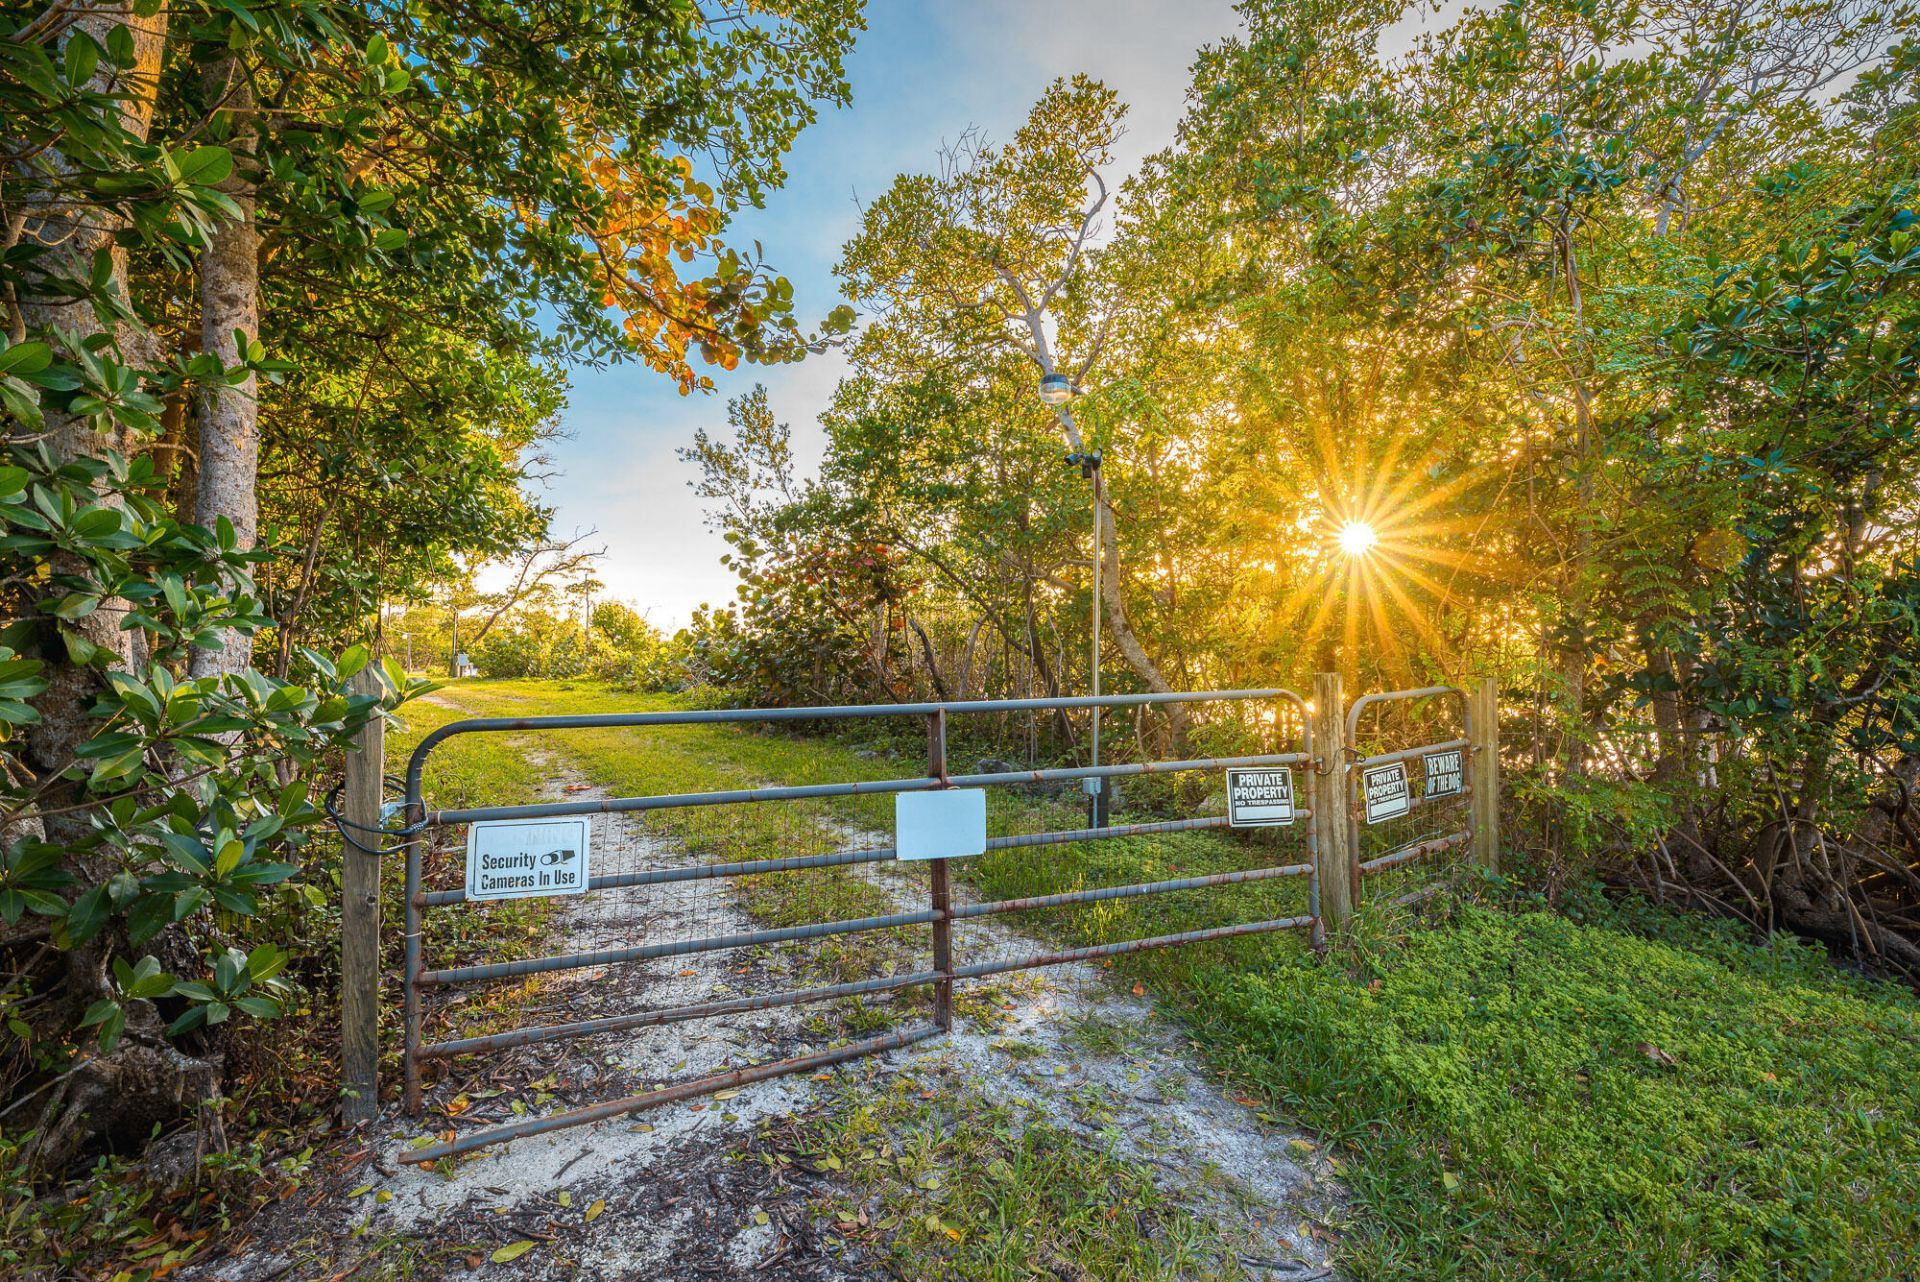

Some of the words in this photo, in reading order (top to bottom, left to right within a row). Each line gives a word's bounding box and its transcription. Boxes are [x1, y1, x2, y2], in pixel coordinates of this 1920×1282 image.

[1428, 754, 1459, 776] BEWARE
[1239, 773, 1283, 786] PRIVATE
[1371, 769, 1400, 786] PRIVATE
[1428, 777, 1436, 794] OF
[1437, 775, 1449, 792] THE
[1233, 786, 1288, 800] PROPERTY
[1369, 780, 1404, 799] PROPERTY
[482, 852, 536, 870] Security
[481, 874, 535, 890] Cameras
[539, 871, 550, 886] In
[555, 870, 575, 885] Use
